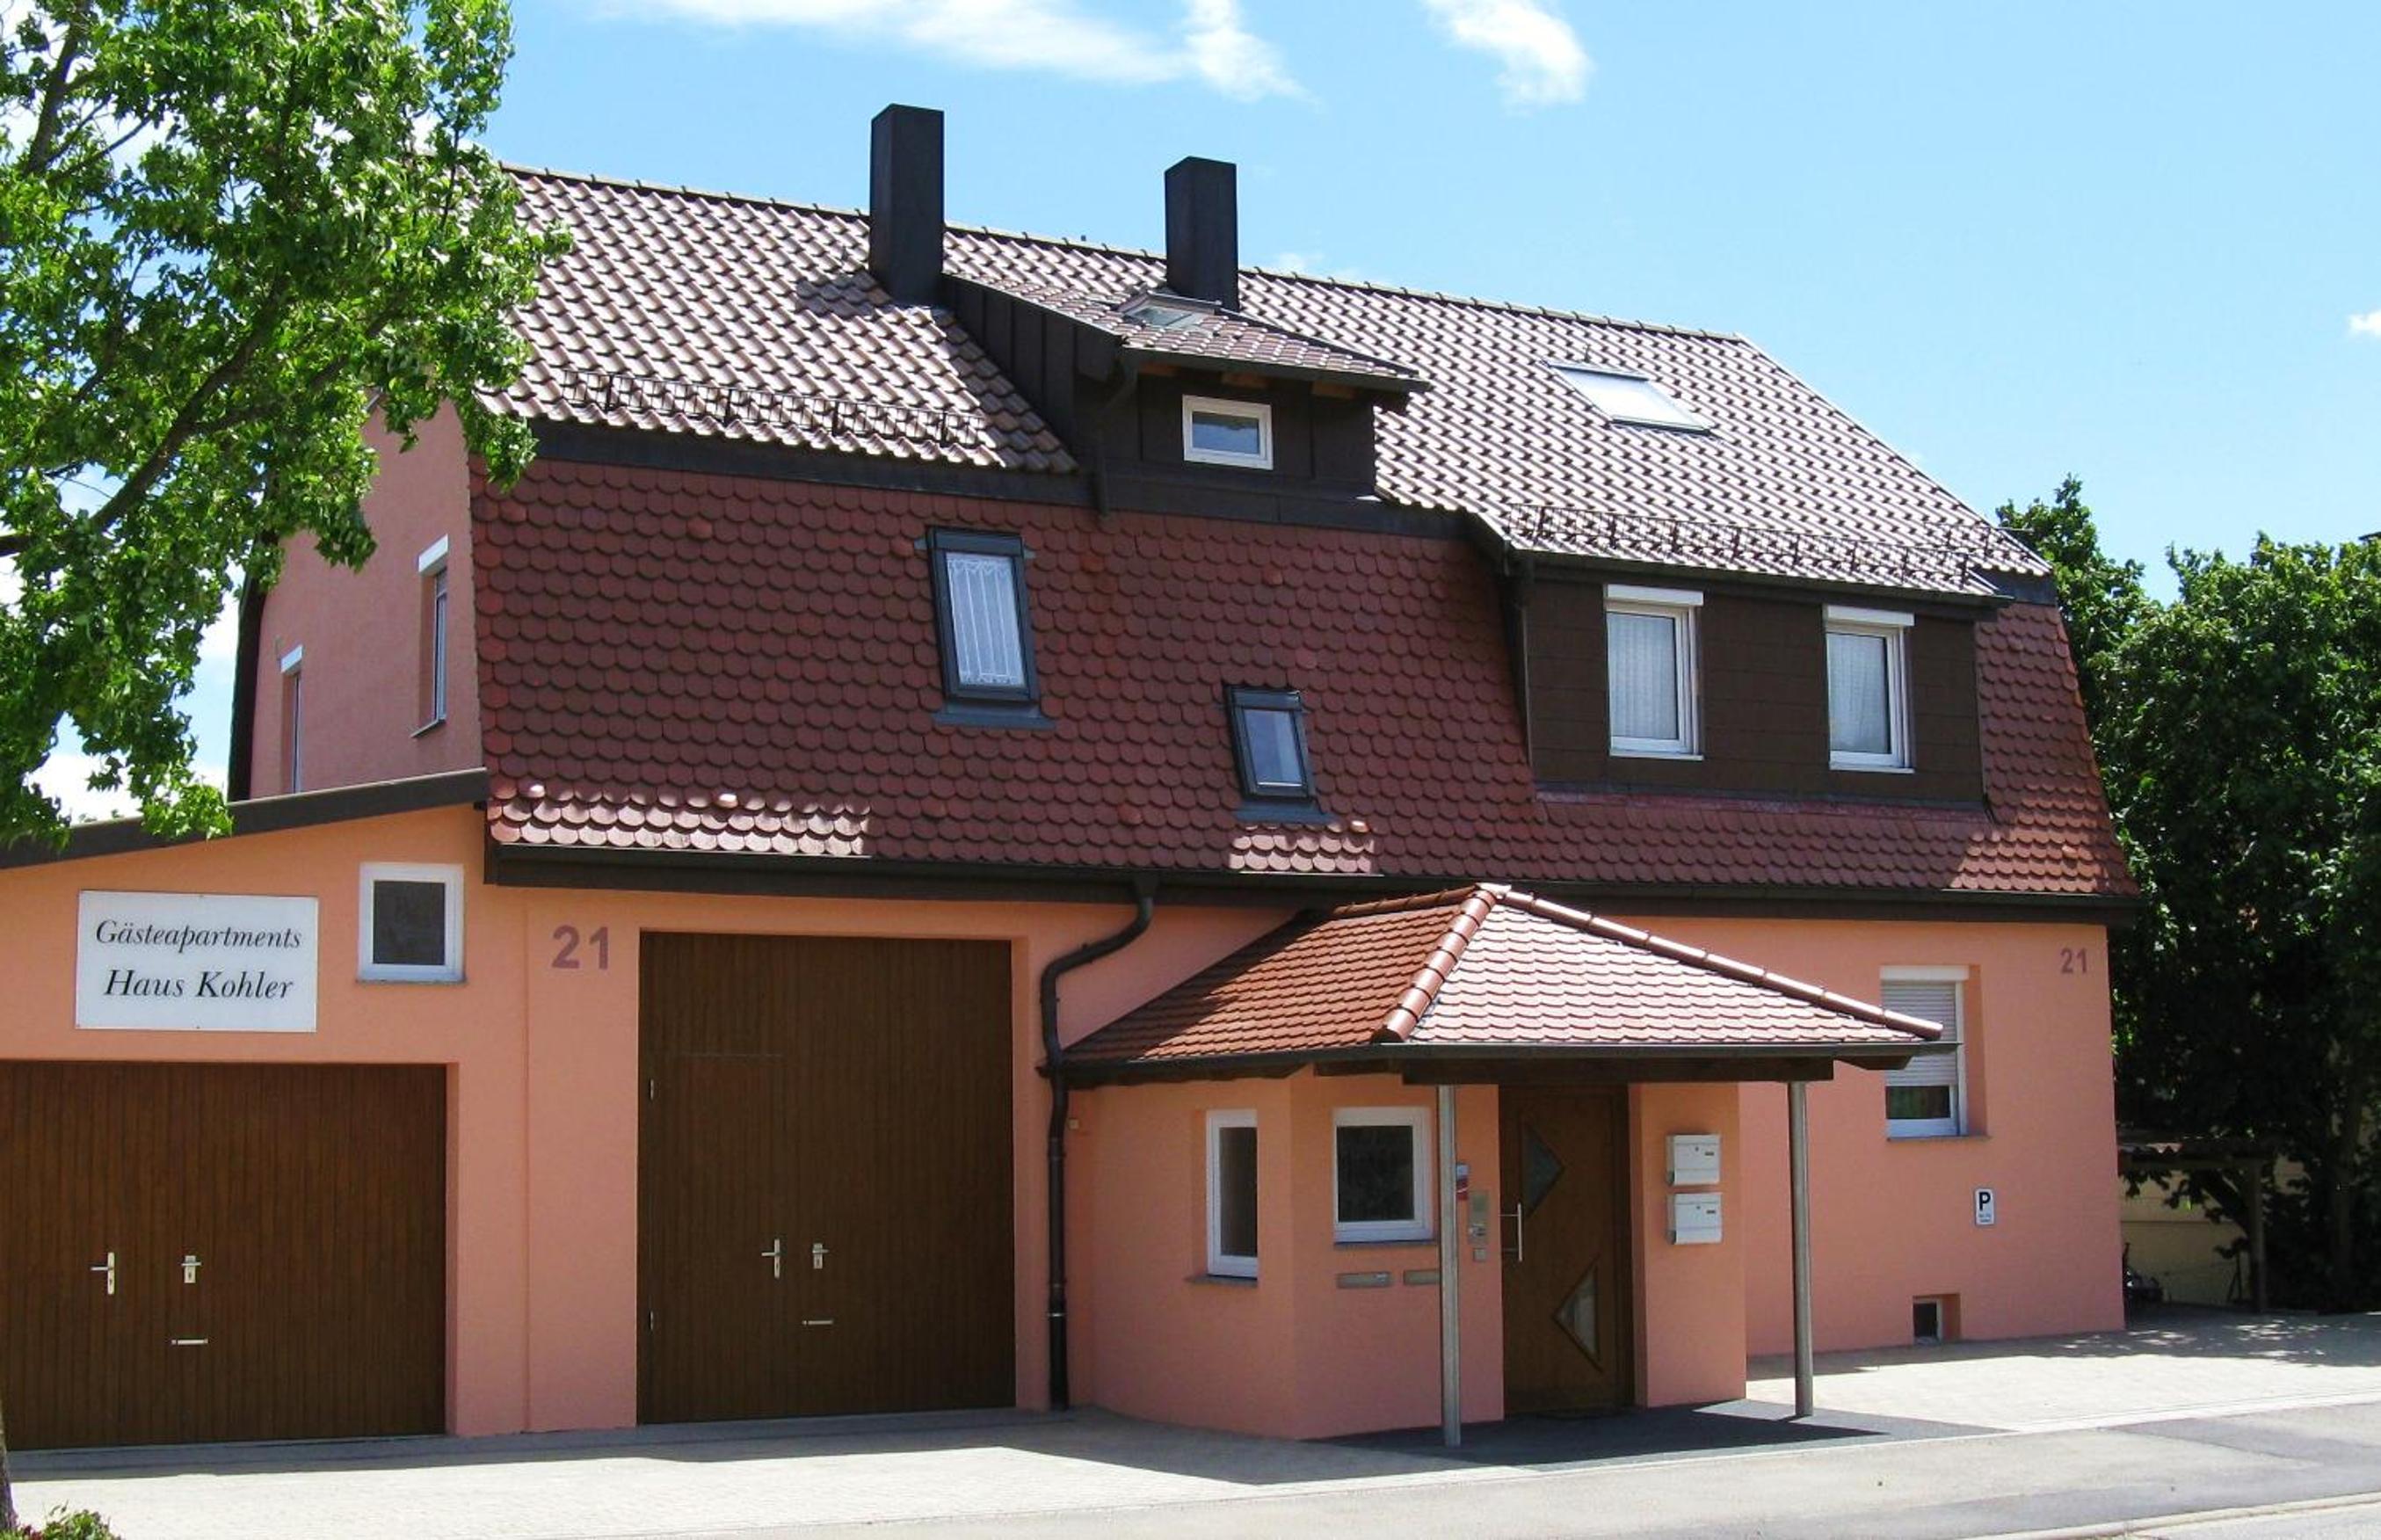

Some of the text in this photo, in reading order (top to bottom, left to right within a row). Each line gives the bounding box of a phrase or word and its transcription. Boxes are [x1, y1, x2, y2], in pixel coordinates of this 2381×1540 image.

[96, 919, 302, 954] Gästeapartments
[551, 925, 609, 970] 21
[2060, 948, 2087, 974] 21
[104, 969, 294, 999] Haus Kohler
[1978, 1191, 1991, 1211] P
